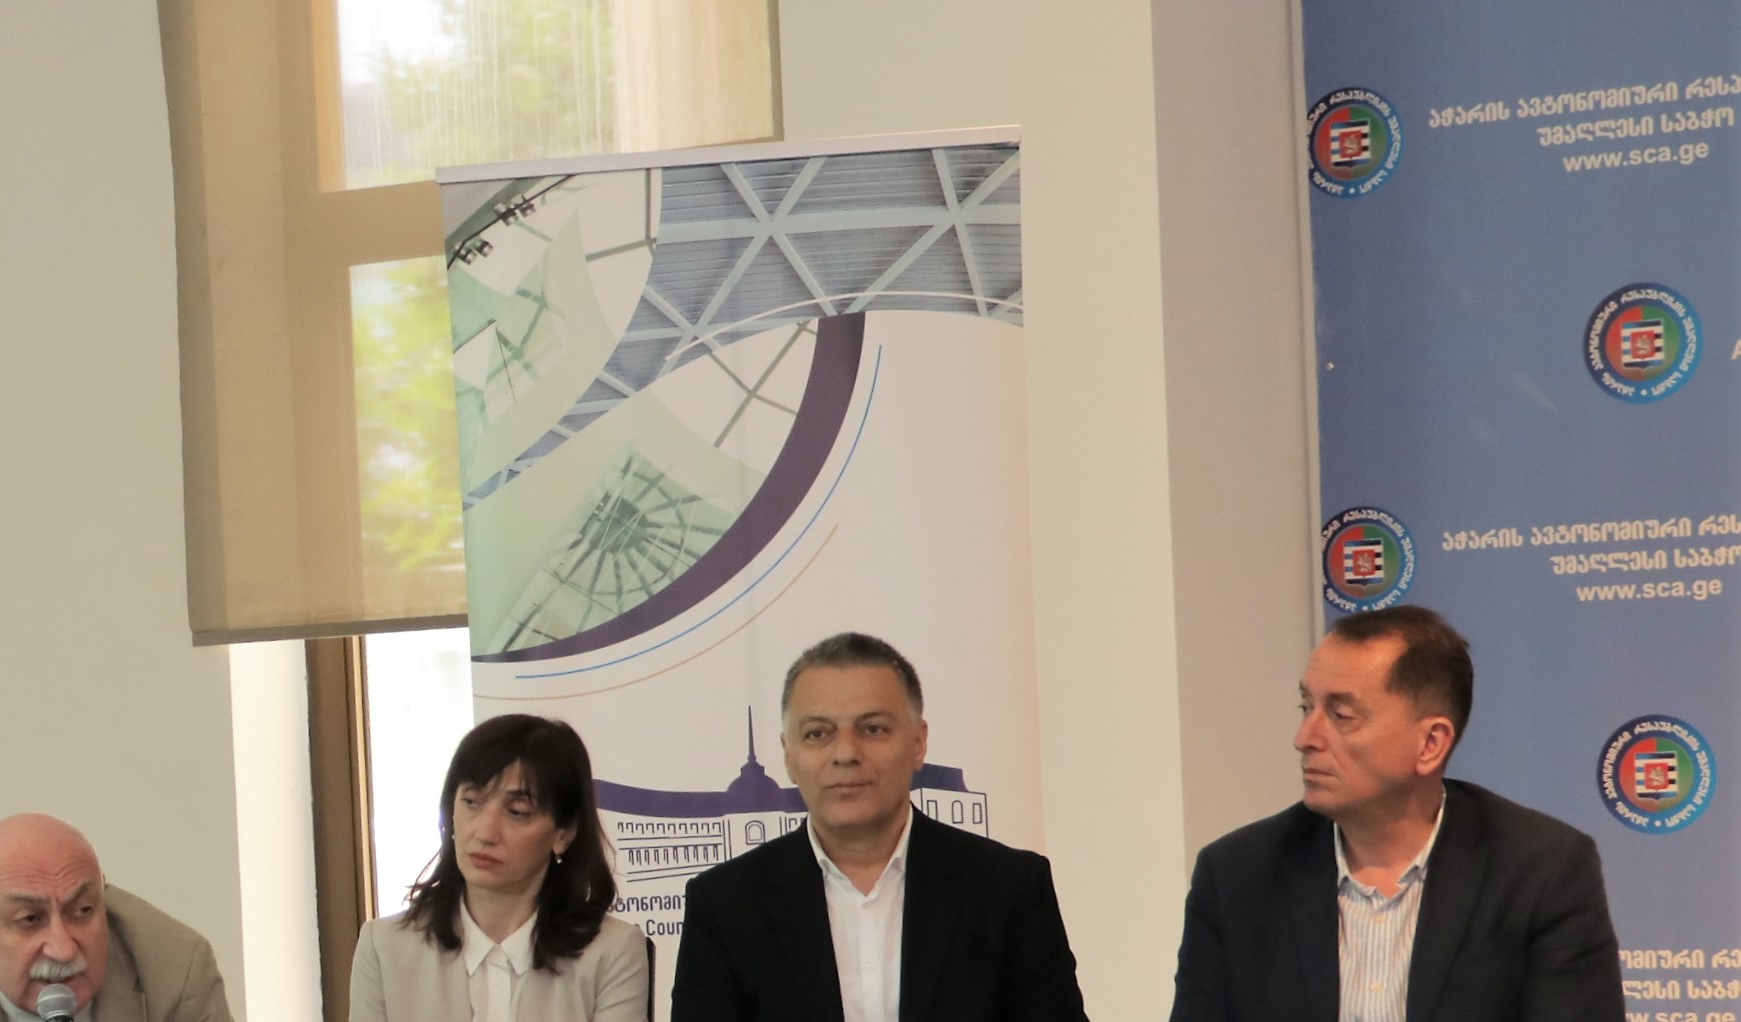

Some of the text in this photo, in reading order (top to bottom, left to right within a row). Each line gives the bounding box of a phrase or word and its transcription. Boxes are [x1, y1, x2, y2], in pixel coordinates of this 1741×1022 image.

[1428, 101, 1510, 128] აჭარის
[1517, 82, 1678, 118] ავტონომიური
[1537, 106, 1734, 146] უმაღლესი საბჭო
[1564, 142, 1710, 172] www.sca.ge
[1442, 528, 1523, 551] აჭარის
[1530, 517, 1692, 546] ავტონომიური
[1550, 550, 1667, 575] უმაღლესი
[1576, 578, 1722, 602] www.sca.ge
[646, 919, 684, 936] Coun
[1618, 949, 1704, 969] ომიური
[1622, 980, 1680, 999] ლესი
